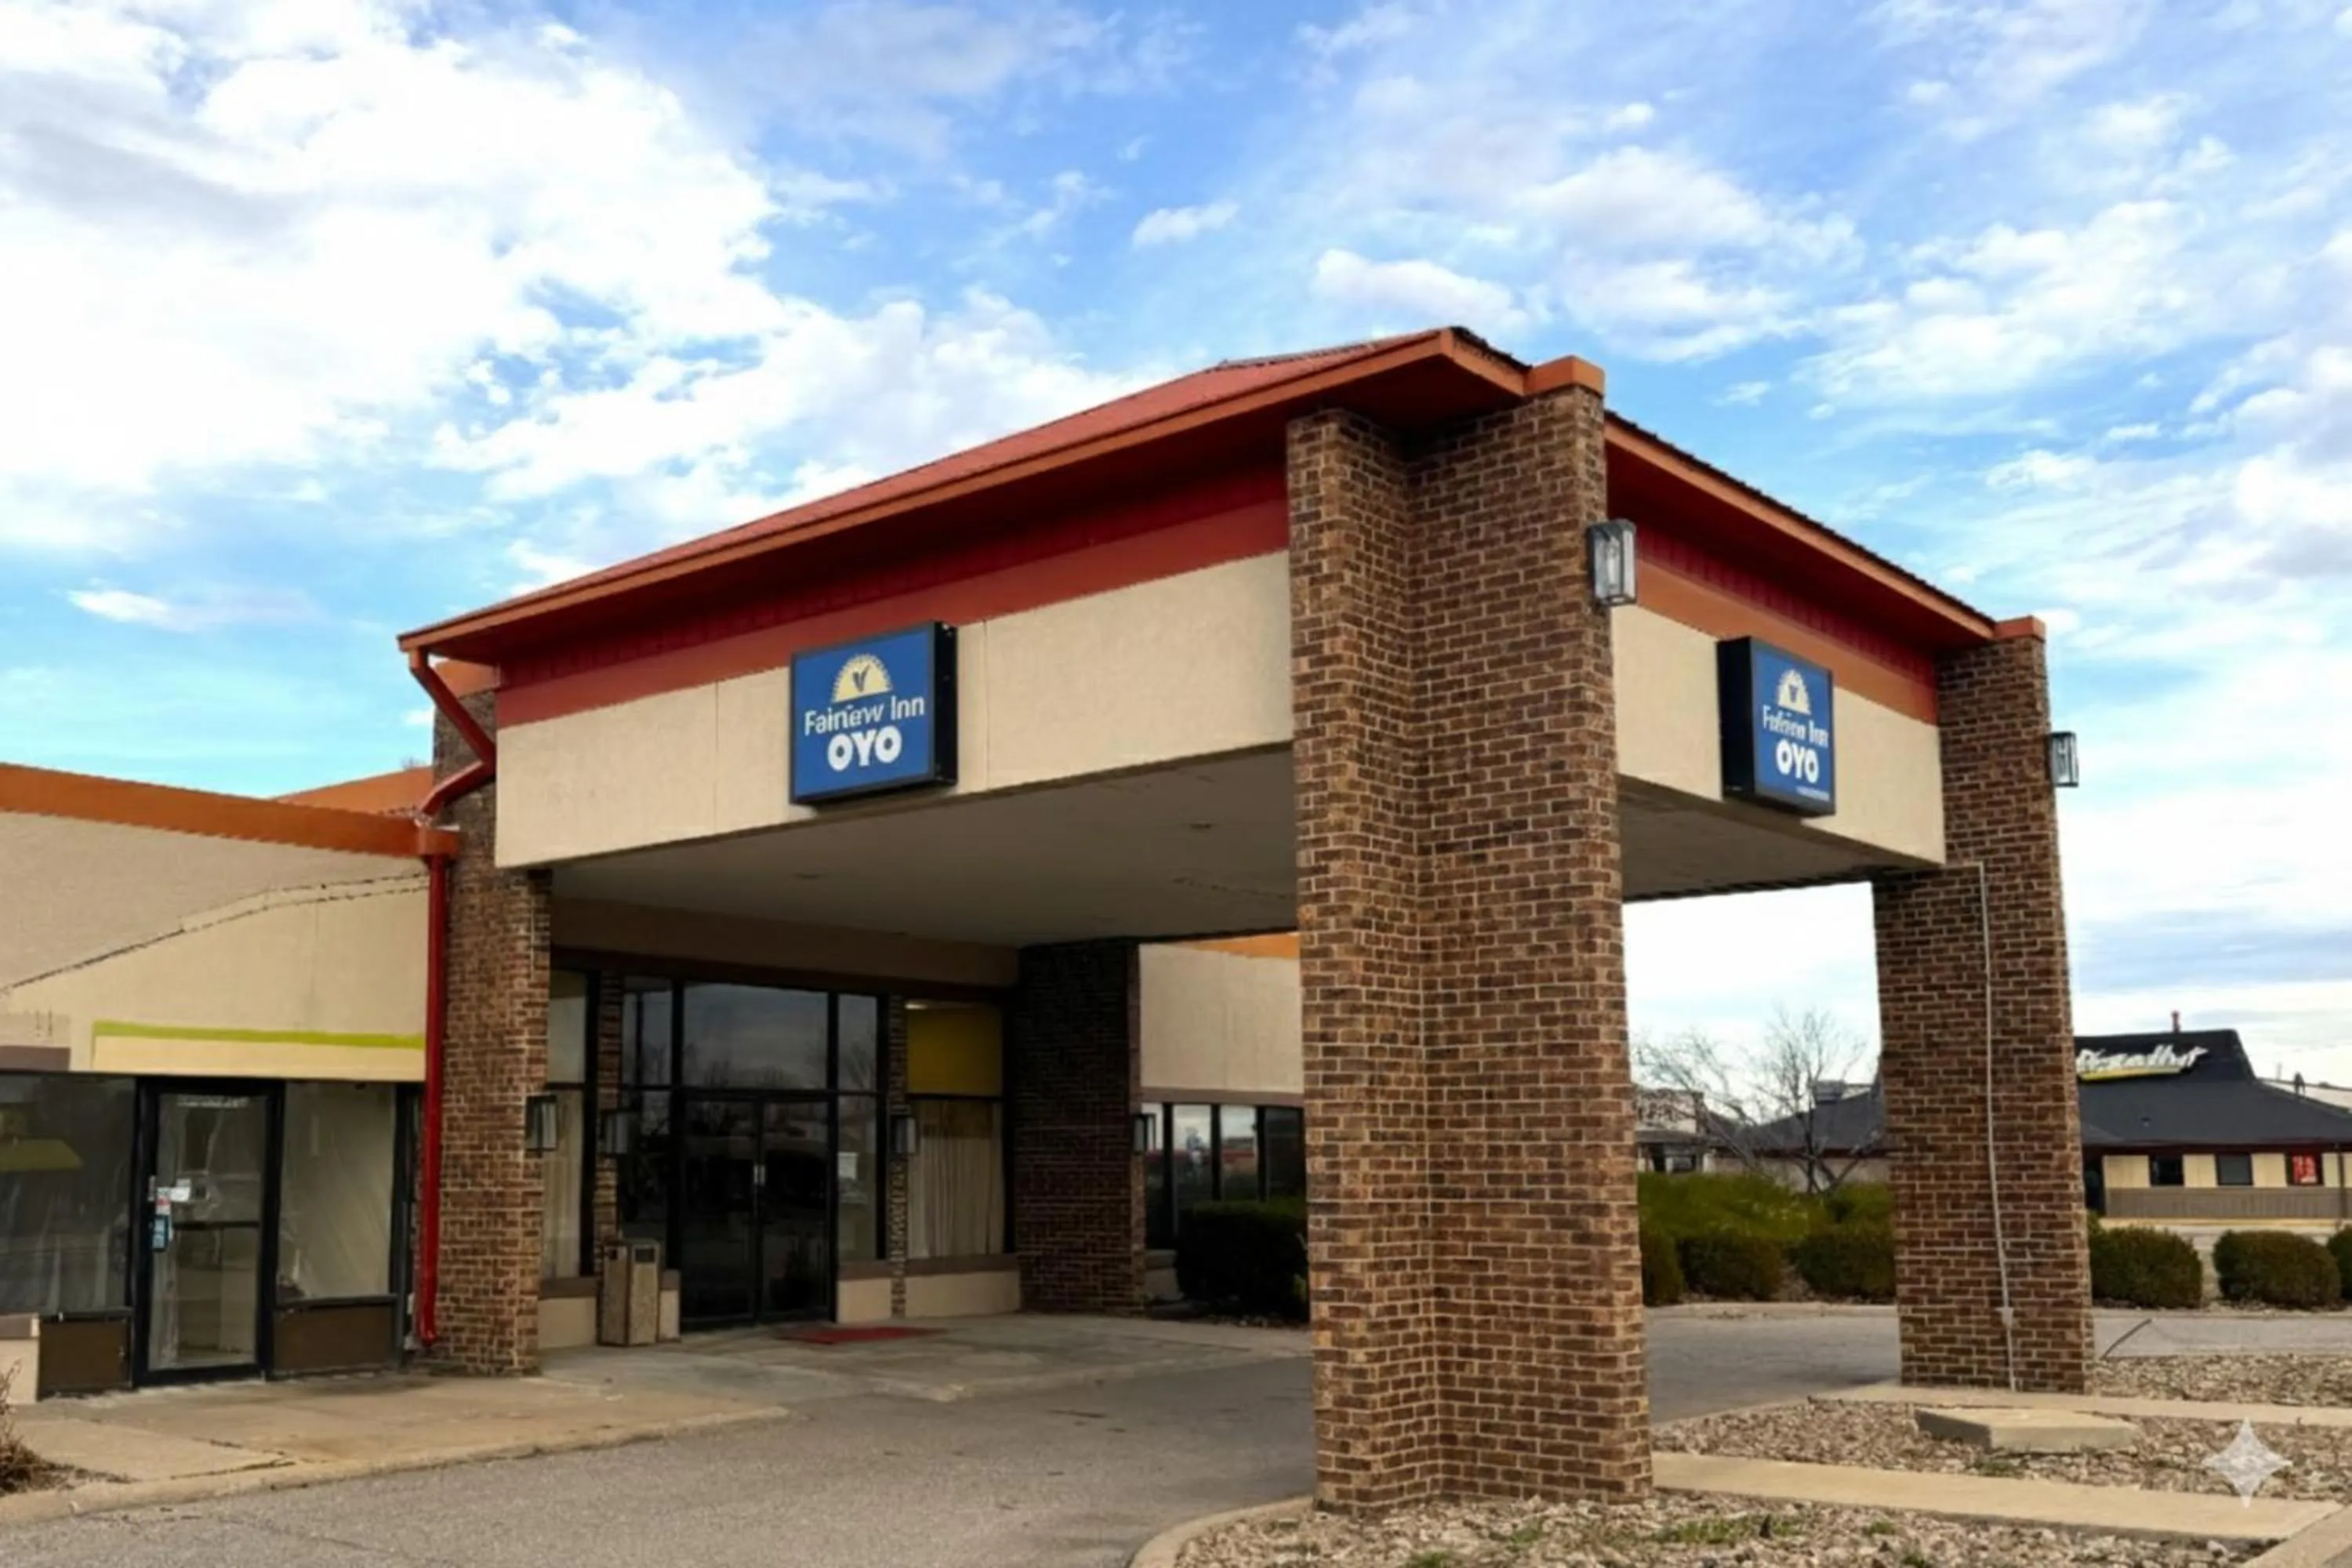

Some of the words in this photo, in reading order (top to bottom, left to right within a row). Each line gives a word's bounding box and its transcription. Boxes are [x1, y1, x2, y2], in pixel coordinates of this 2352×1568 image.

[891, 695, 925, 720] Inn
[827, 725, 902, 772] OYO
[1776, 739, 1819, 784] OYO
